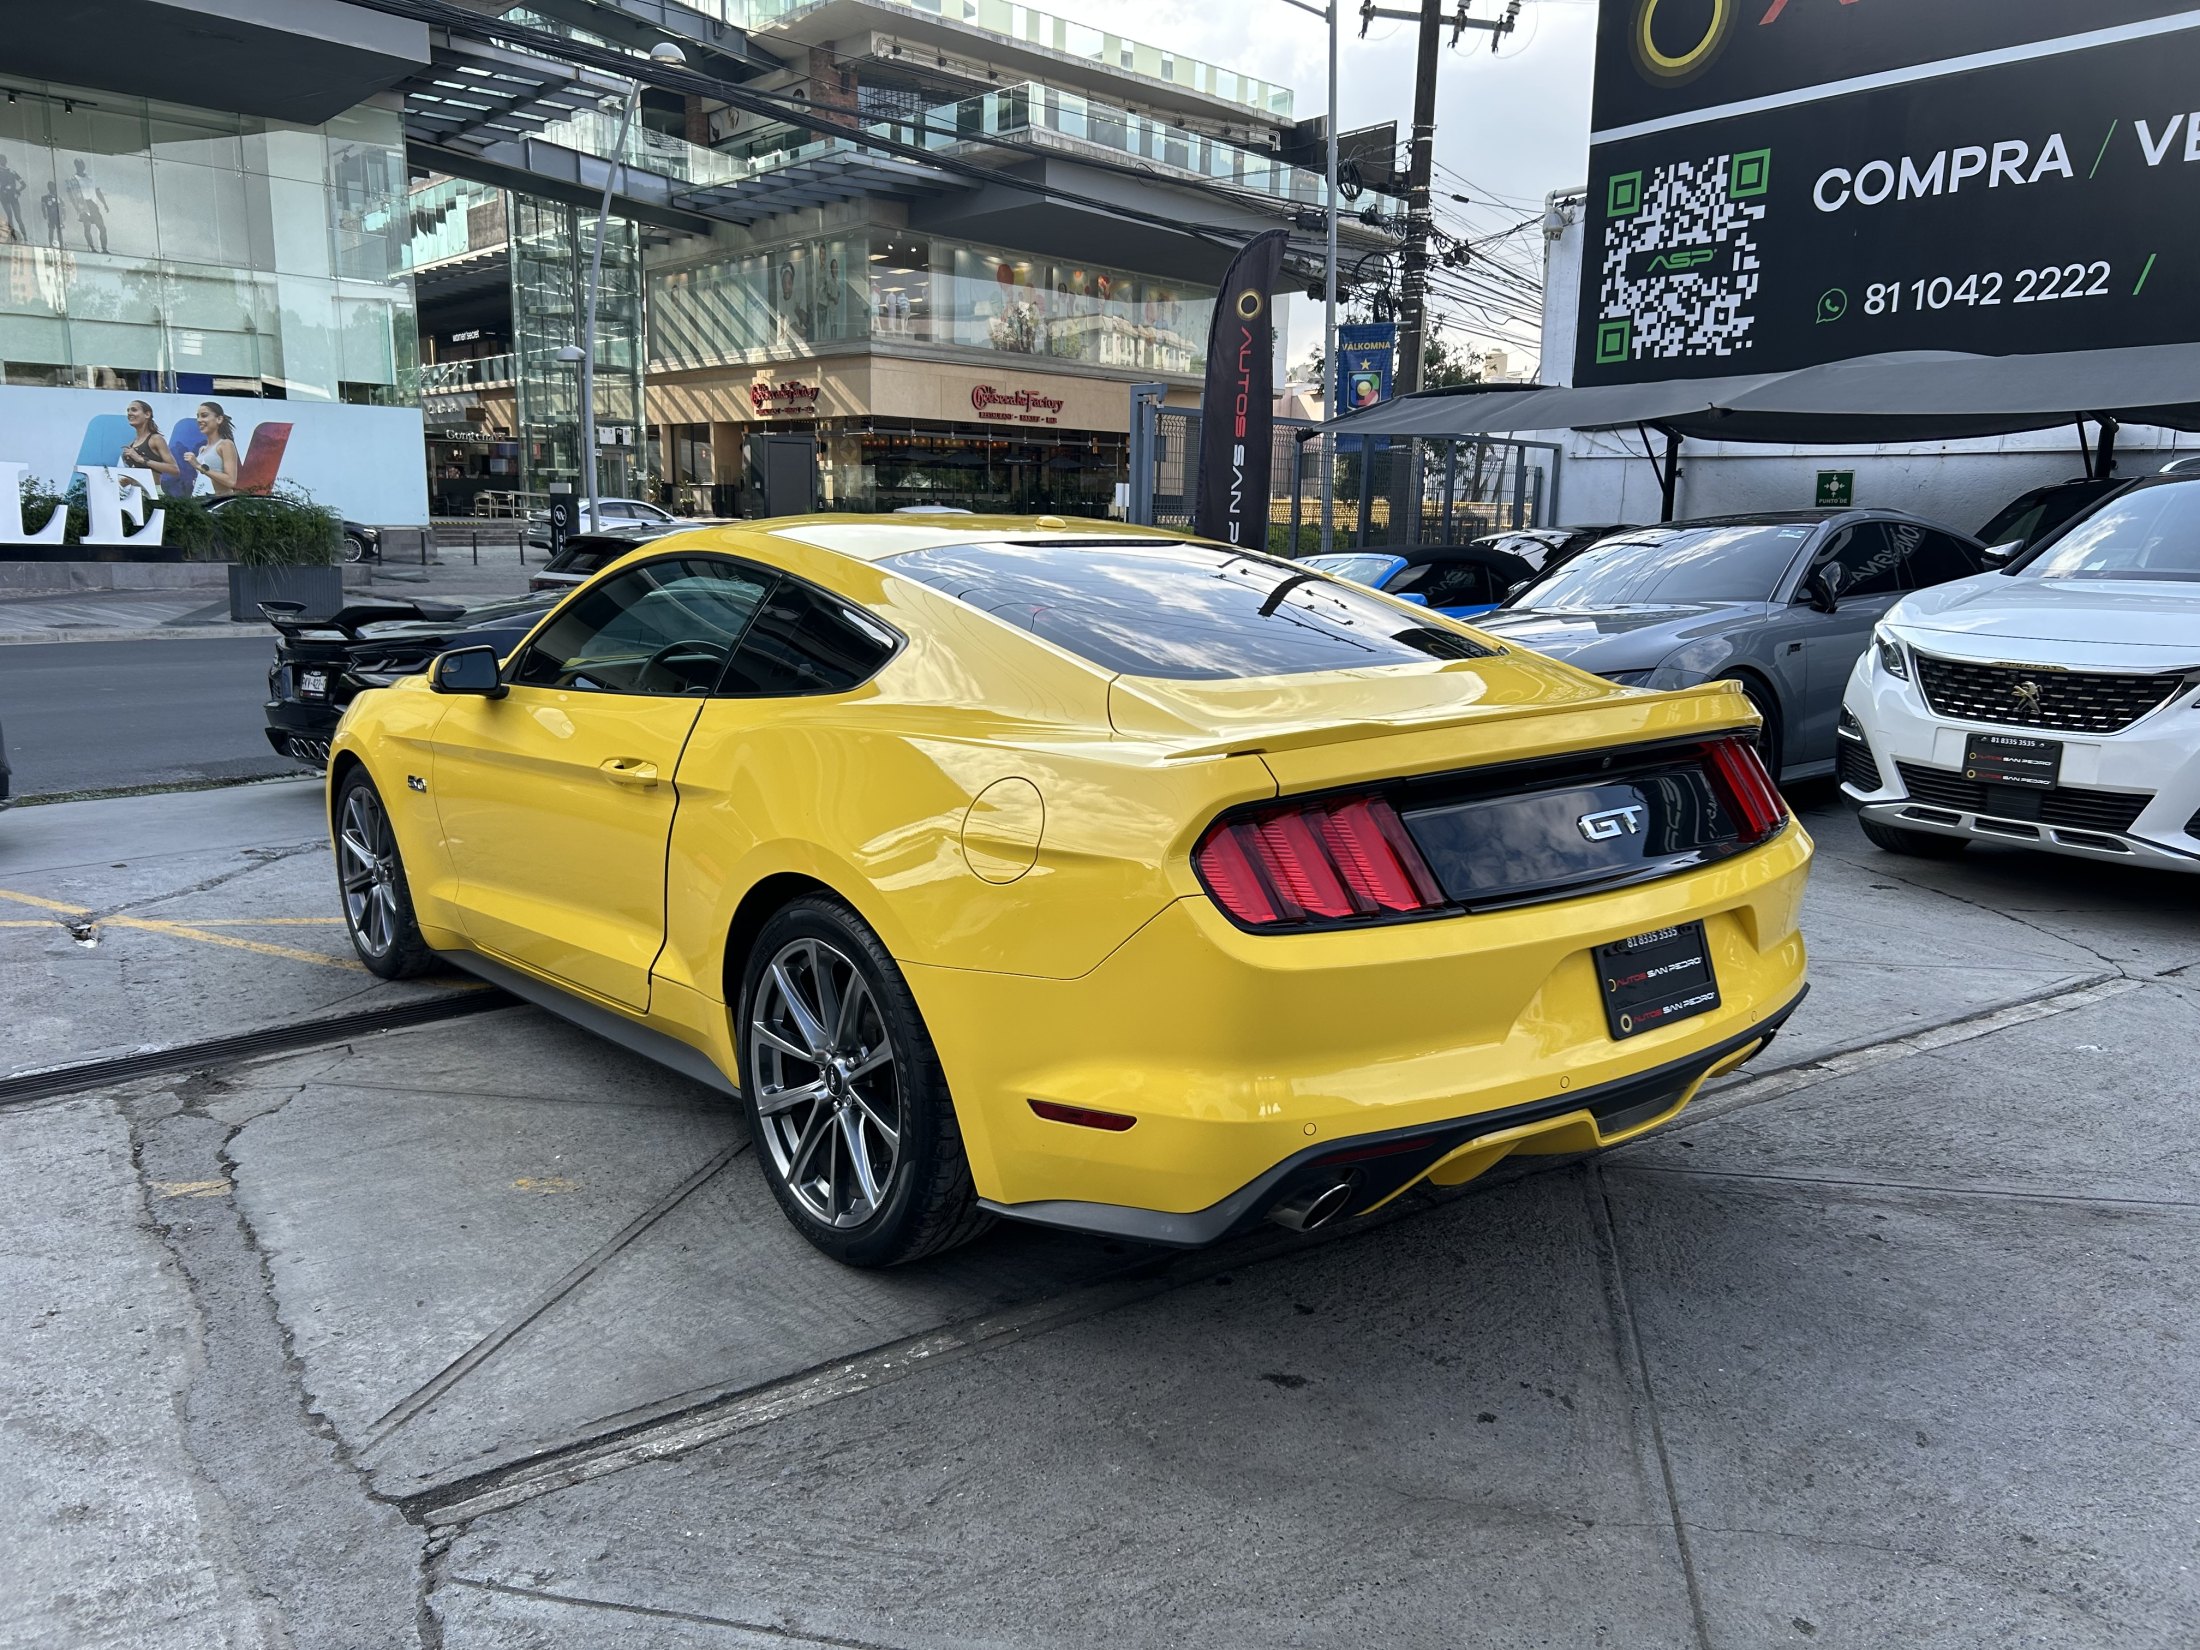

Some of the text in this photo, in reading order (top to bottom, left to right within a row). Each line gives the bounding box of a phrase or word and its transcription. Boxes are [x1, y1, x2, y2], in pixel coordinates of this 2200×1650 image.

[1812, 133, 2074, 213] COMPRA
[1646, 249, 1714, 273] ASP
[1863, 281, 1900, 316] 81
[1910, 271, 2003, 312] 1042
[2012, 260, 2112, 304] 2222
[1234, 326, 1253, 438] AUTOS
[1021, 389, 1064, 414] Factory
[1228, 443, 1245, 515] SAN
[2000, 737, 2018, 746] 8335
[2018, 739, 2036, 747] 3535
[2021, 758, 2053, 767] PEDRO
[2020, 777, 2052, 785] PEDRO
[1577, 804, 1643, 843] GT
[1626, 926, 1678, 948] 81 8335 3535
[1616, 957, 1702, 987] AUTOS SAN PEDRO
[1632, 992, 1715, 1024] AUTOS SAN PEDRO
